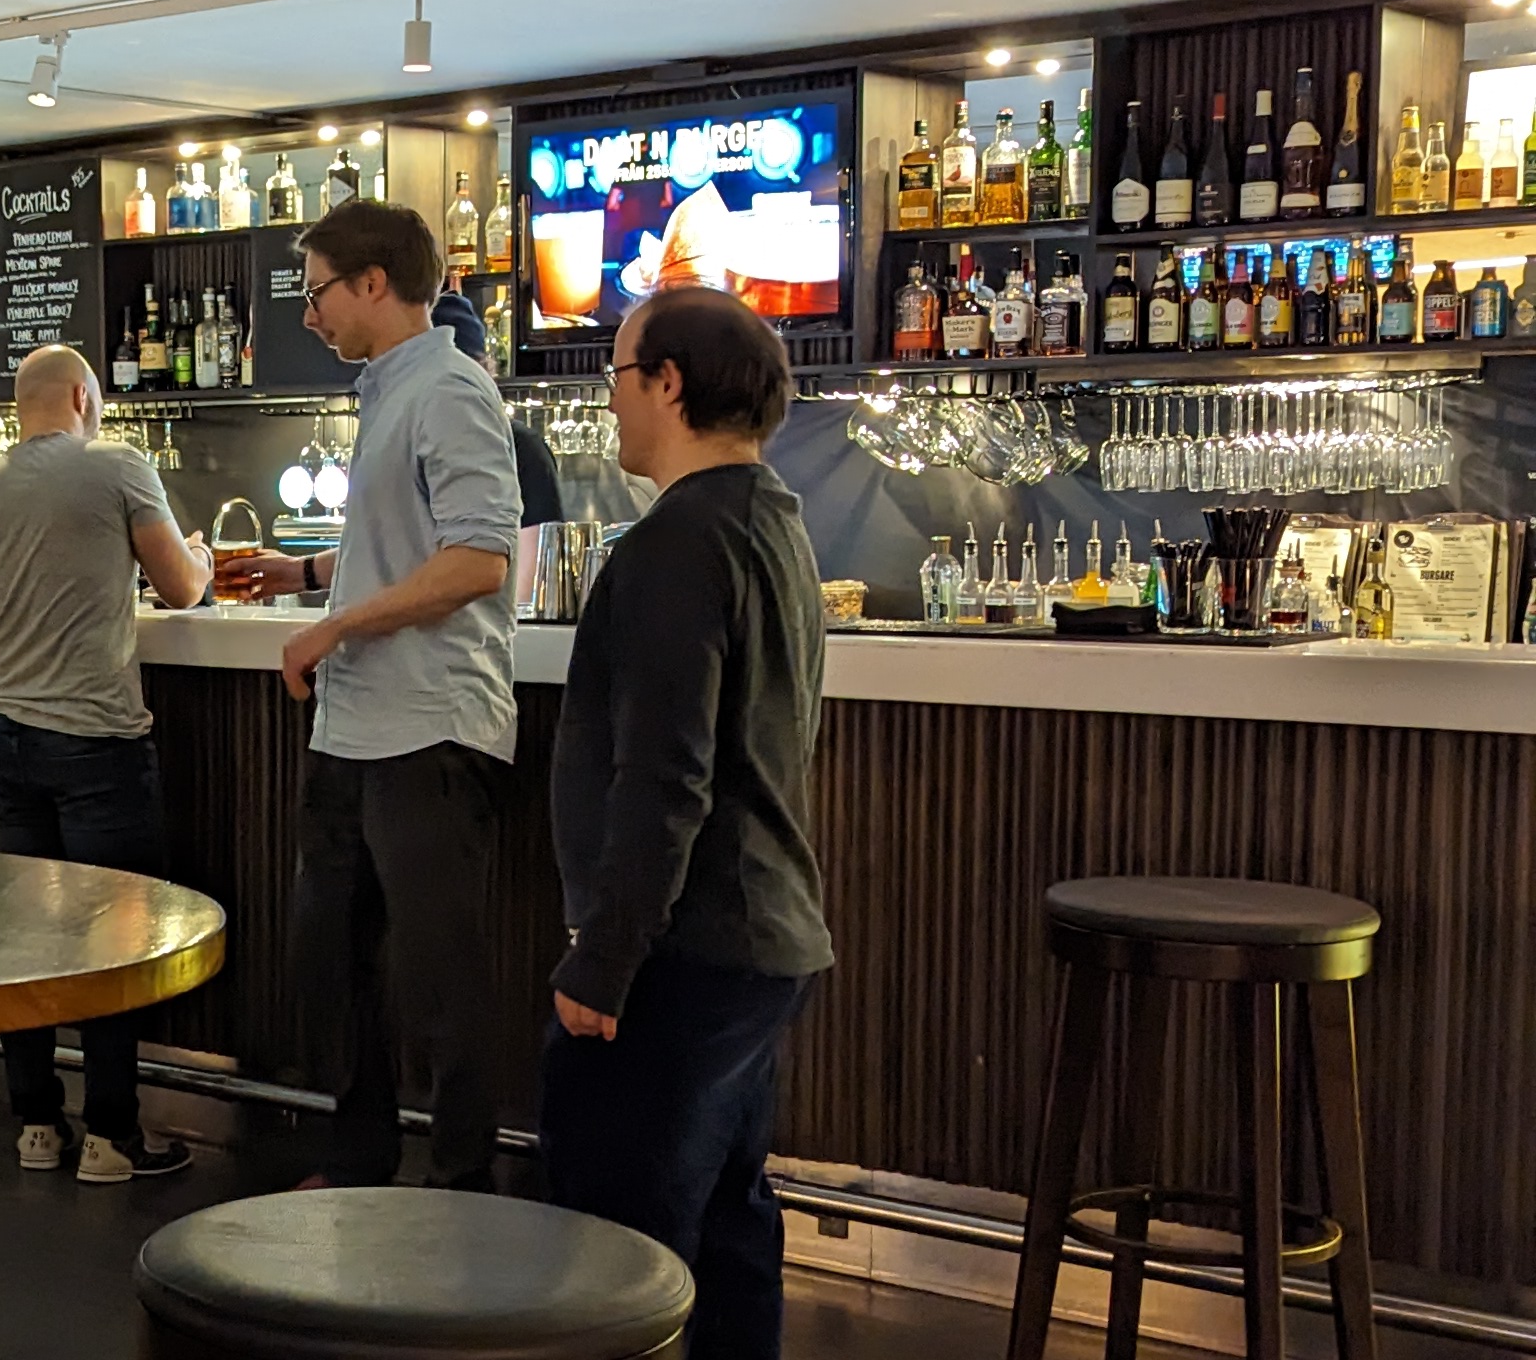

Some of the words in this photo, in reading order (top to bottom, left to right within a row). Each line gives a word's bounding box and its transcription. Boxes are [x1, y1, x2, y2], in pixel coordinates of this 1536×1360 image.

[583, 133, 646, 167] DAT
[651, 131, 669, 160] N
[714, 156, 753, 173] ERSON
